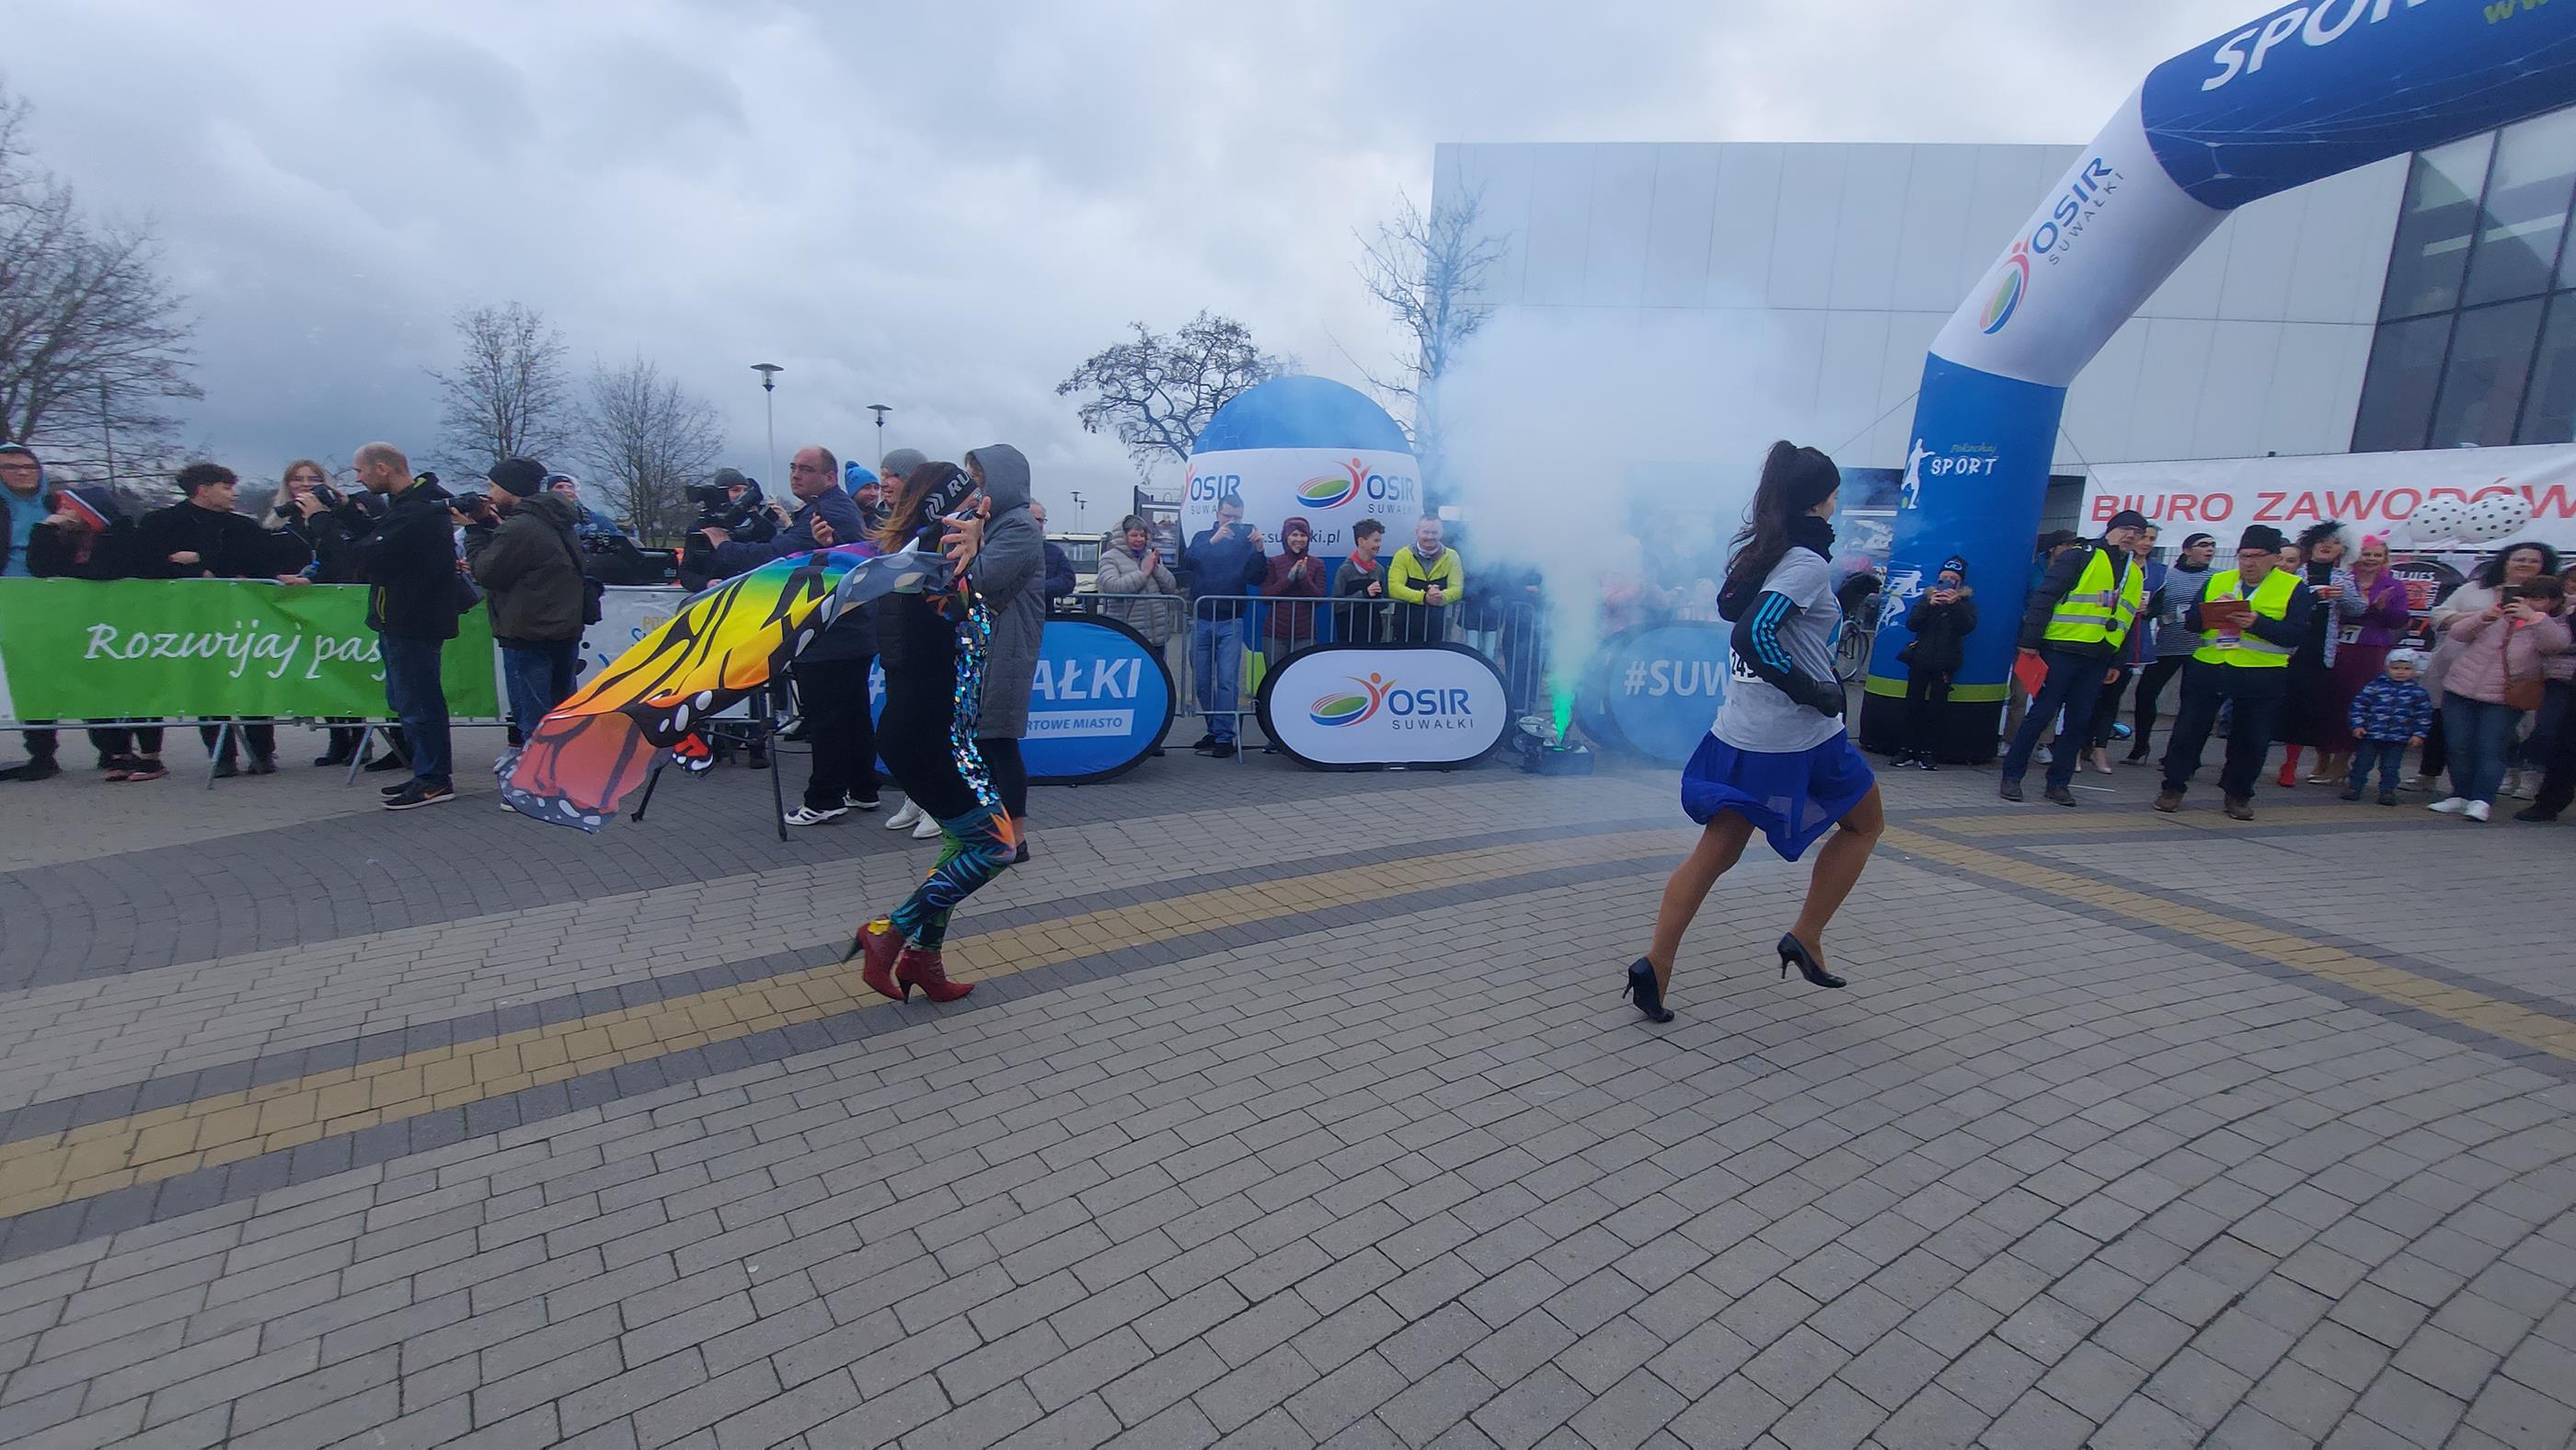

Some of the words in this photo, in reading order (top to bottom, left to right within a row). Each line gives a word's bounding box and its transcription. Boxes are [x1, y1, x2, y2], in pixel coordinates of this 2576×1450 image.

[2202, 0, 2429, 91] SPO
[2032, 157, 2113, 254] OSIR
[2049, 172, 2124, 266] SUWAŁKI
[1931, 456, 1999, 476] SPORT
[947, 471, 971, 498] RU
[1190, 474, 1241, 501] OSIR
[1366, 475, 1416, 501] OSIR
[2091, 493, 2234, 522] BIURO
[2252, 477, 2576, 522] ZAWOW
[84, 619, 302, 678] Rozwijaj
[305, 634, 386, 681] pas
[1387, 689, 1472, 716] OSIR
[1028, 719, 1072, 731] RTOWE
[1074, 717, 1123, 730] MIASTO
[1392, 719, 1474, 731] SUWAŁKI
